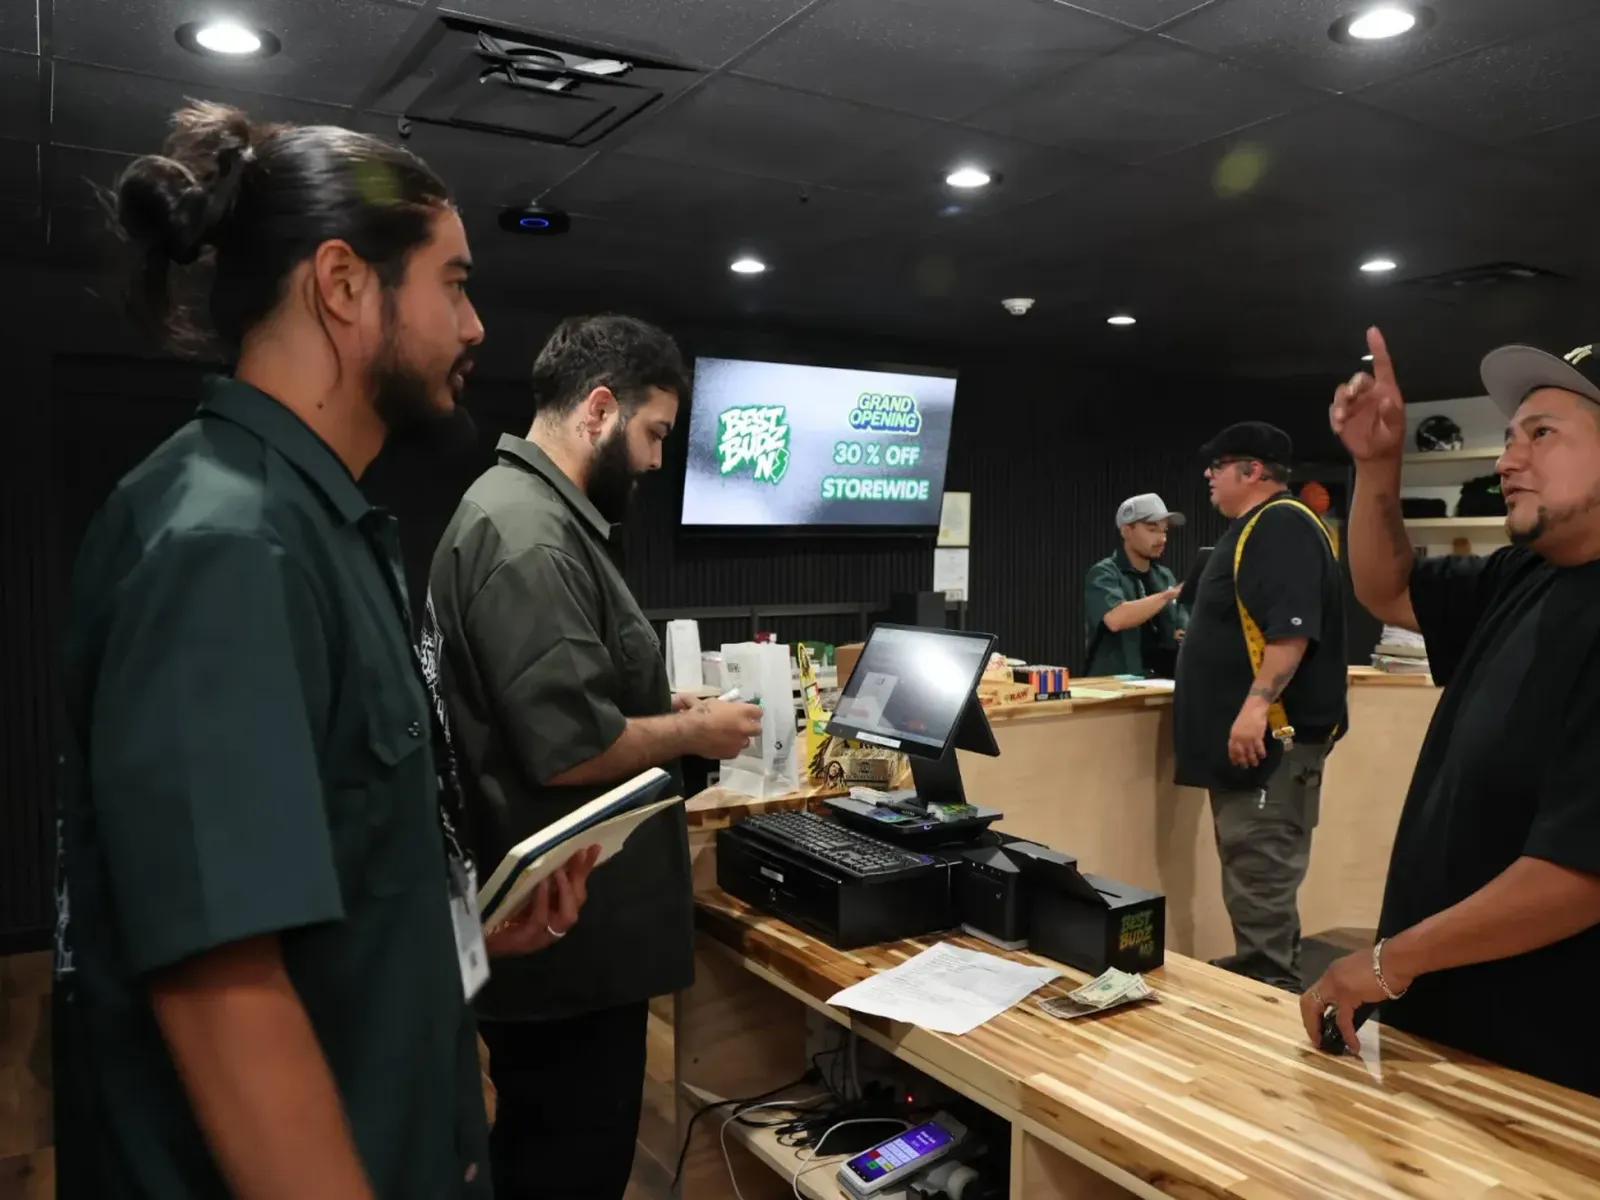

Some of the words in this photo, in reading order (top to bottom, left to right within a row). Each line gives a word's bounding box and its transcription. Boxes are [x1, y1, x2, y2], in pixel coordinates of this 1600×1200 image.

[859, 394, 913, 412] GRAND
[720, 407, 785, 442] BEST
[850, 409, 919, 430] OPENING
[718, 425, 788, 474] BUDZ
[834, 441, 862, 464] 30
[866, 442, 881, 465] %
[885, 445, 920, 466] OFF
[822, 478, 930, 500] STOREWIDE
[1009, 688, 1029, 701] RAW
